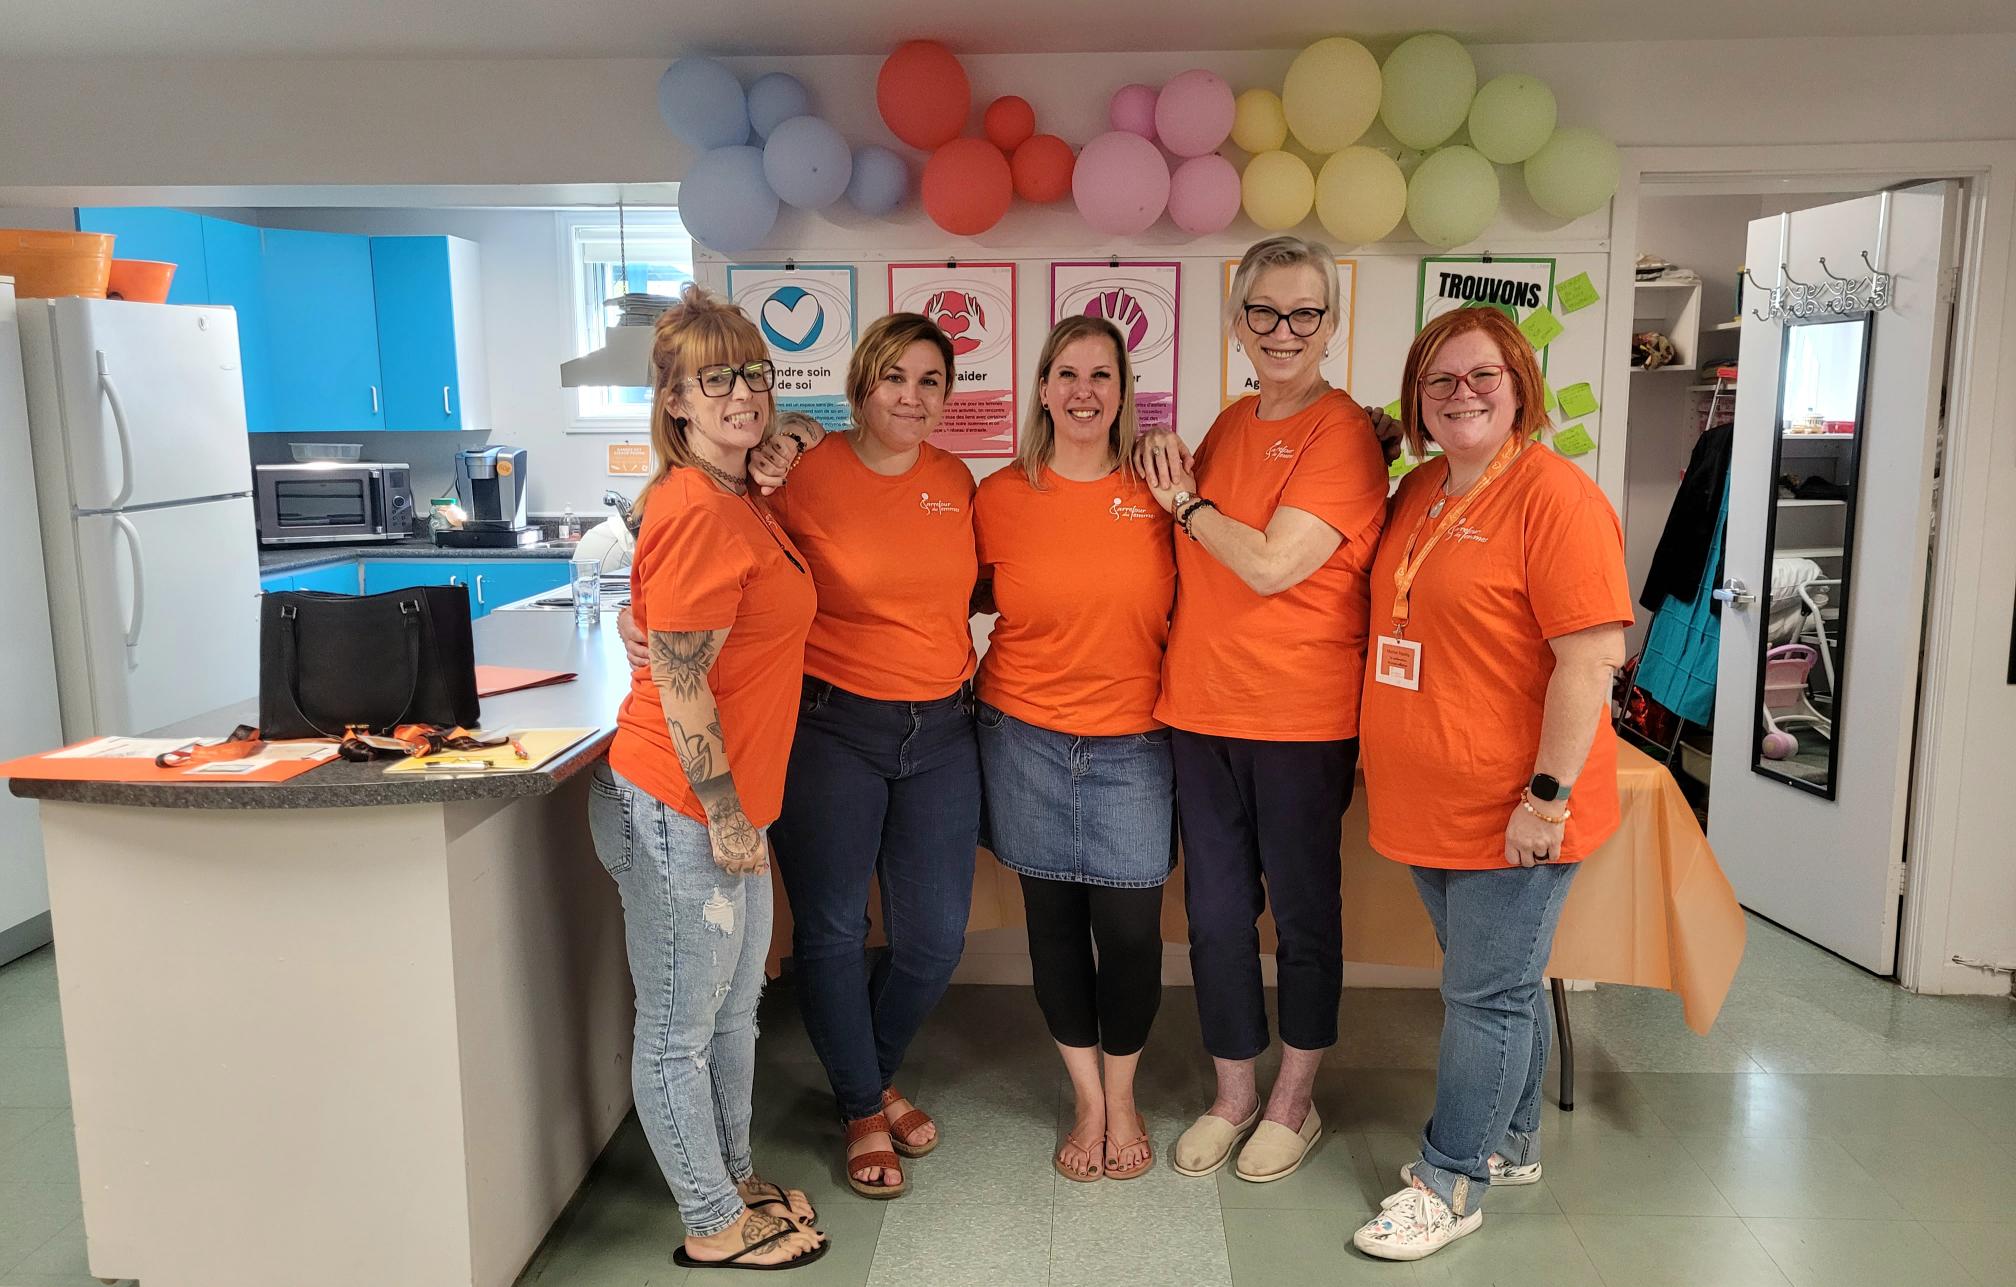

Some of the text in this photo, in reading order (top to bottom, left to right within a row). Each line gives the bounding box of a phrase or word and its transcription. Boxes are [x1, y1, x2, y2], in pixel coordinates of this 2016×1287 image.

[1439, 272, 1541, 308] TROUVONS
[776, 366, 831, 377] ndre soin
[956, 371, 987, 381] aider
[777, 380, 812, 389] de soi
[1244, 377, 1260, 390] Ag
